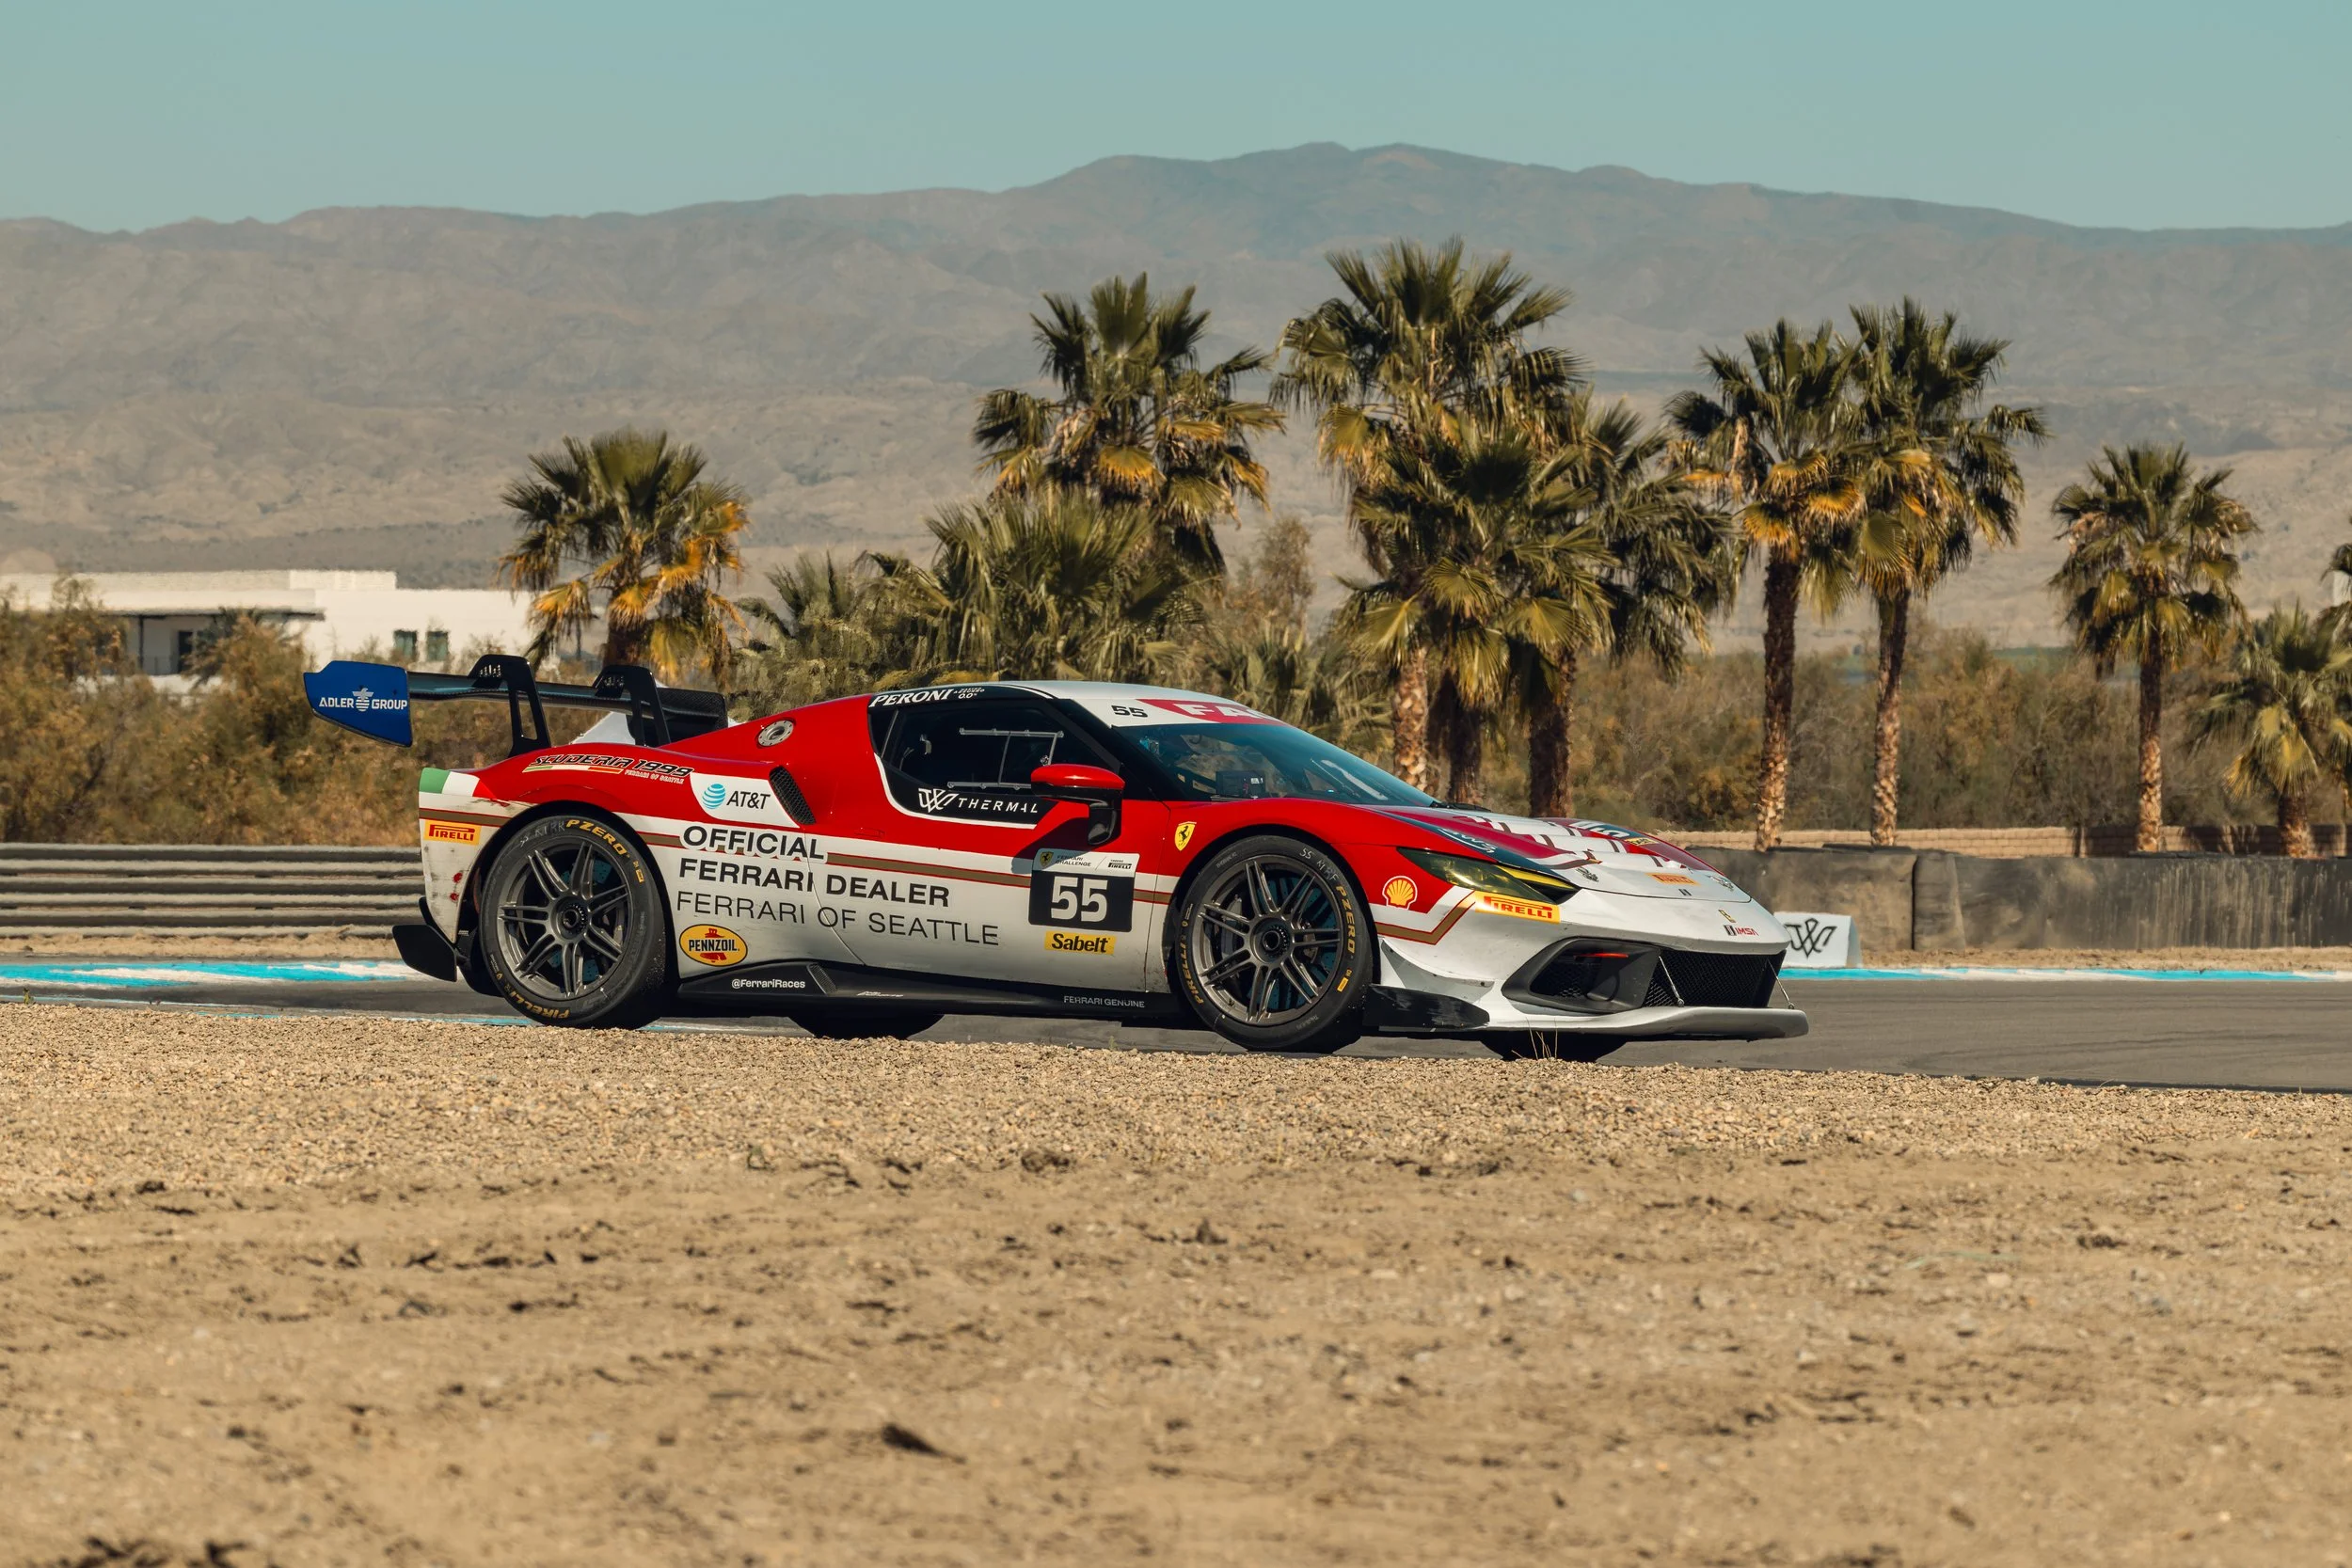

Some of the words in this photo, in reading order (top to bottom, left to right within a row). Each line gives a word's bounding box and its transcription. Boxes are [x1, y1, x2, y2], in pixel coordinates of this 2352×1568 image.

[319, 697, 354, 708] ADLER
[371, 699, 407, 710] GROUP
[868, 689, 954, 707] PERONI
[1111, 705, 1148, 718] 55
[534, 754, 634, 768] SCUDERIA
[634, 759, 694, 777] 1999
[726, 790, 771, 810] AT&T
[958, 798, 1038, 813] THERMAL
[429, 824, 476, 841] PIRELLI
[683, 826, 824, 860] OFFICIAL
[679, 858, 813, 892] FERRARI
[826, 874, 949, 907] DEALER
[1051, 876, 1108, 922] 55
[1484, 895, 1552, 919] PIRELLI
[676, 891, 805, 924] FERRARI
[817, 906, 856, 929] OF
[868, 912, 999, 946] SEATTLE
[1736, 927, 1759, 936] IMSA
[689, 939, 738, 952] PENNZOIL
[1052, 933, 1108, 953] Sabelt
[731, 978, 805, 989] @FerrariRaces
[1180, 942, 1204, 1005] PIRELLI
[510, 990, 570, 1019] PIRELLI
[1063, 995, 1103, 1006] FERRARI
[1104, 998, 1145, 1008] GENUINE
